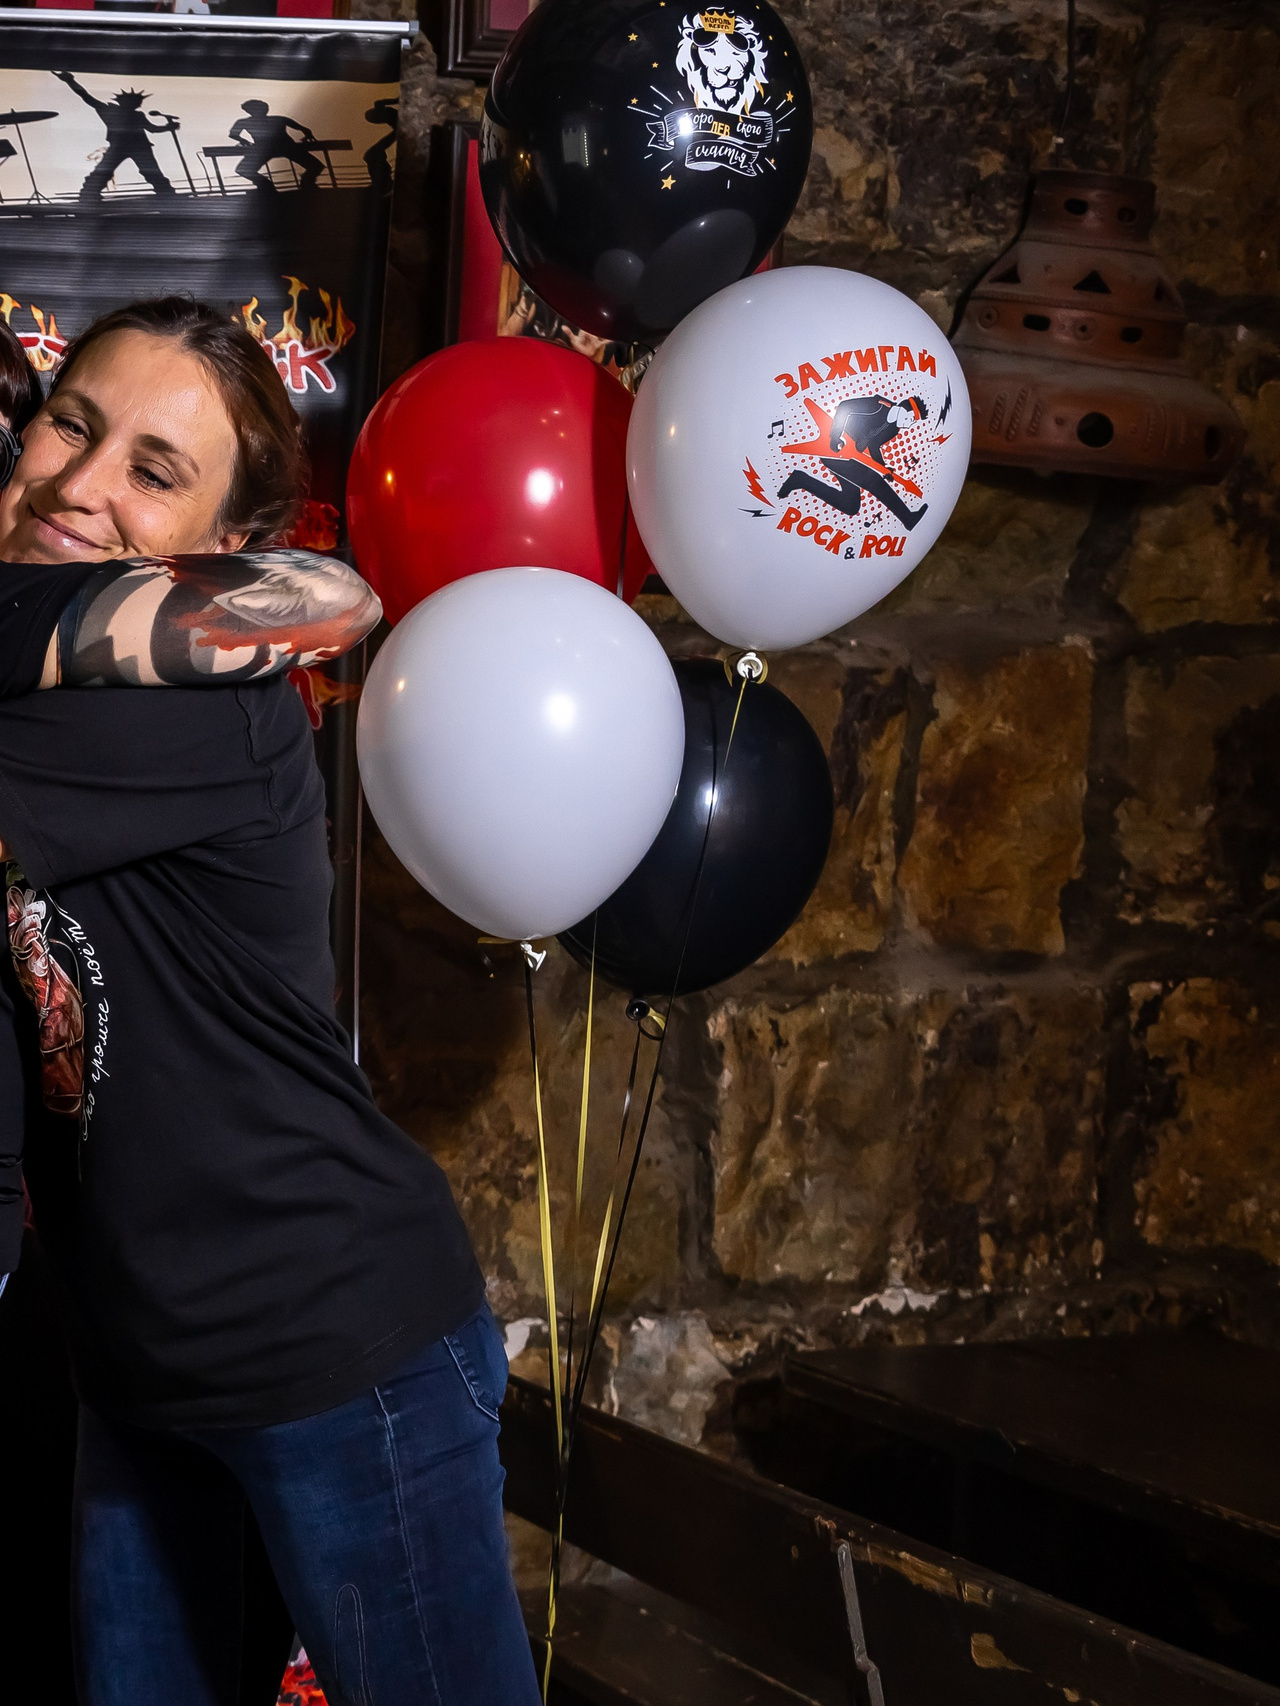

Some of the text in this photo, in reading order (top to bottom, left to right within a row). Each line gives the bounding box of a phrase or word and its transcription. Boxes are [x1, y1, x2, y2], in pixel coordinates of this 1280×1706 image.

[695, 144, 748, 169] счастья
[774, 345, 936, 398] ЗАЖИГАЙ
[777, 506, 907, 559] ROCK & ROLL
[91, 998, 110, 1082] громче
